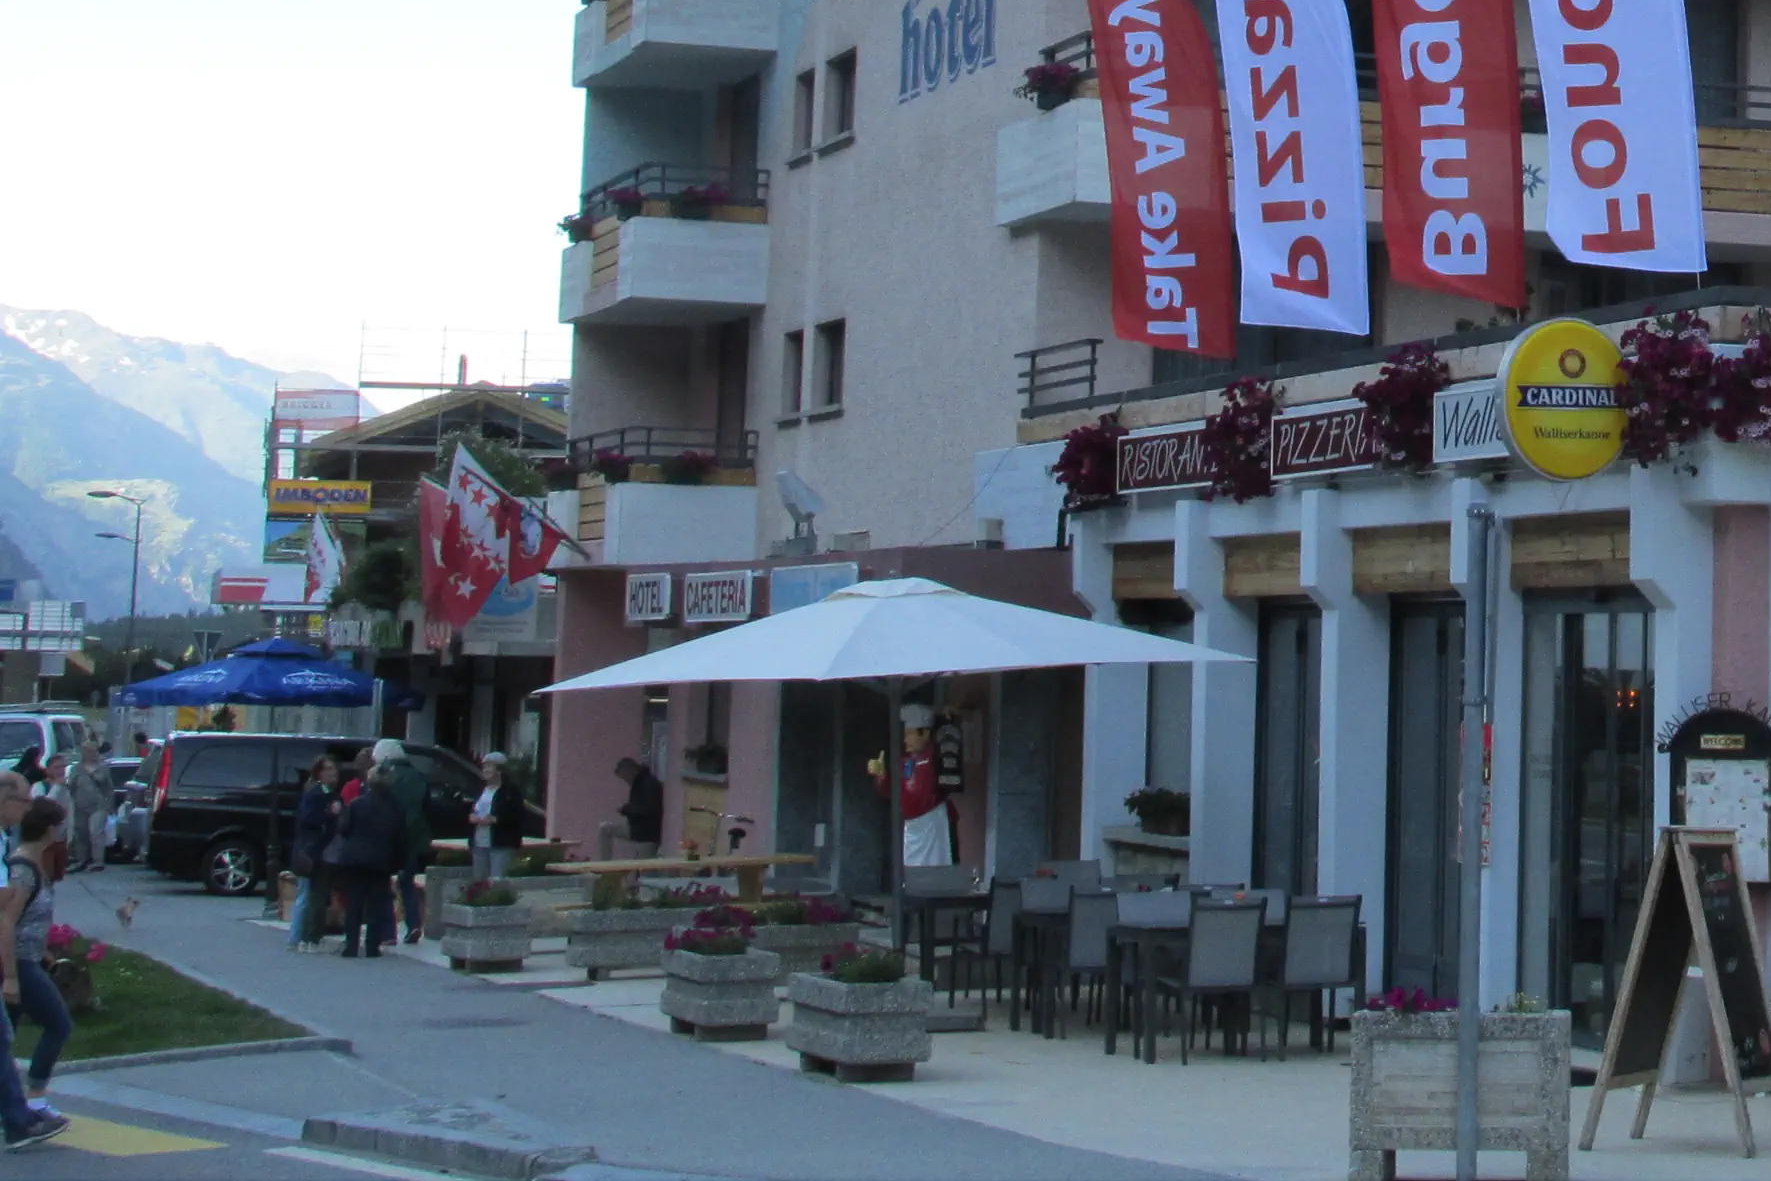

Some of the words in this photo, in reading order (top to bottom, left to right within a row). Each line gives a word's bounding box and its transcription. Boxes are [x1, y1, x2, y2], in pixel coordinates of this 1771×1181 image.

[1526, 387, 1618, 407] CARDINAL
[1121, 434, 1219, 486] RISTORAN
[275, 487, 368, 503] IMBODEN
[630, 581, 662, 613] HOTEL
[686, 577, 746, 615] CAFETERIA
[1655, 692, 1732, 746] WALLISER
